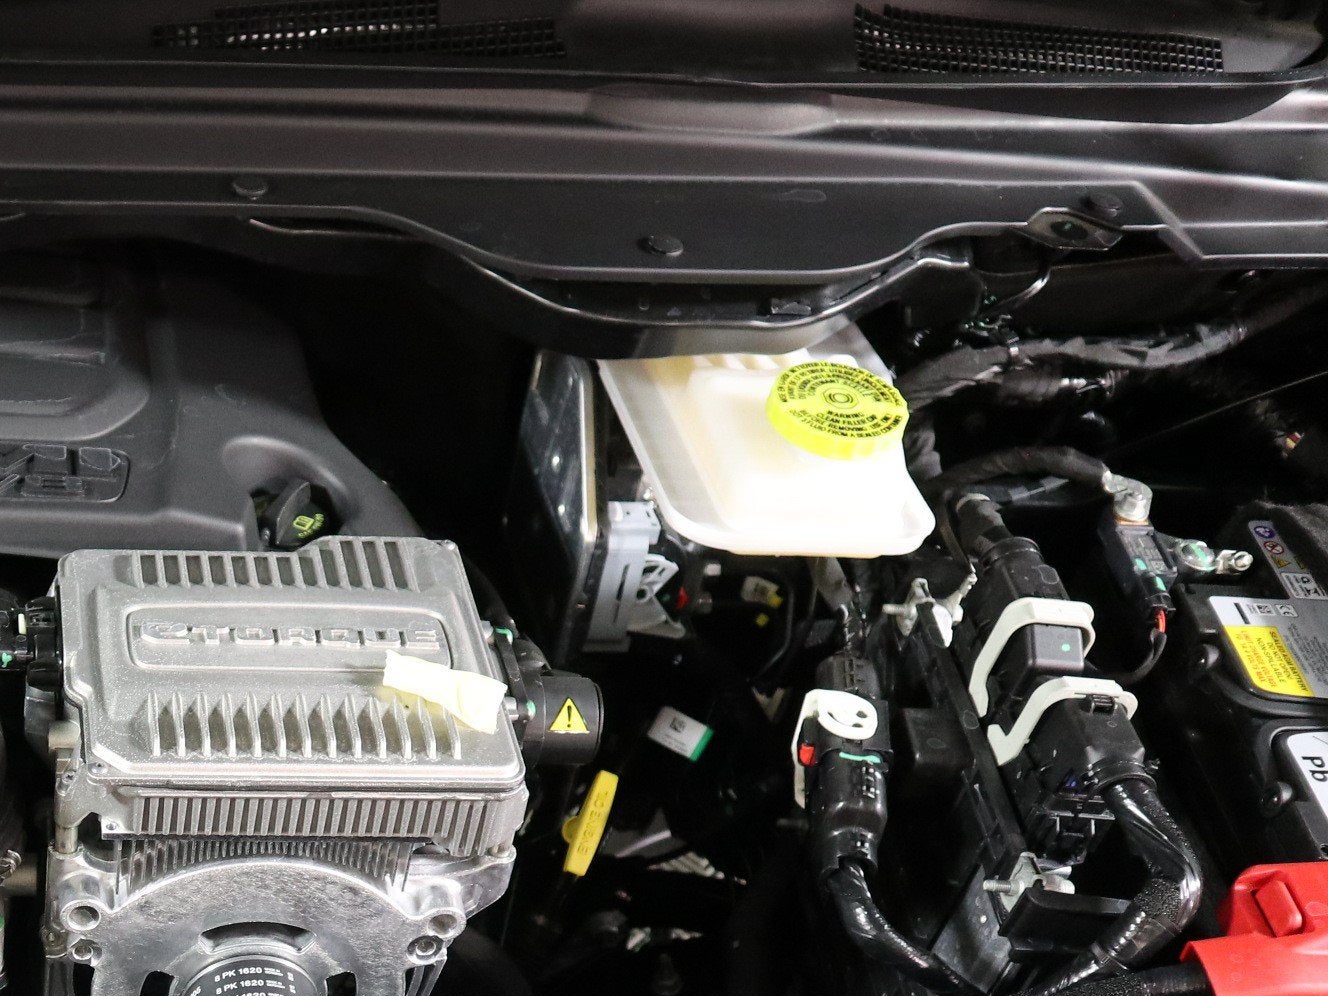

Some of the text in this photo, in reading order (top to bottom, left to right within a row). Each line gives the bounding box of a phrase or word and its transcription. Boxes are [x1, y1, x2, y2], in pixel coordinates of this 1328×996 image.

[1301, 755, 1328, 783] Pb
[222, 969, 236, 980] PK
[238, 967, 263, 975] 1620
[215, 987, 222, 995] 8
[223, 982, 238, 992] PK
[240, 979, 264, 987] 1620
